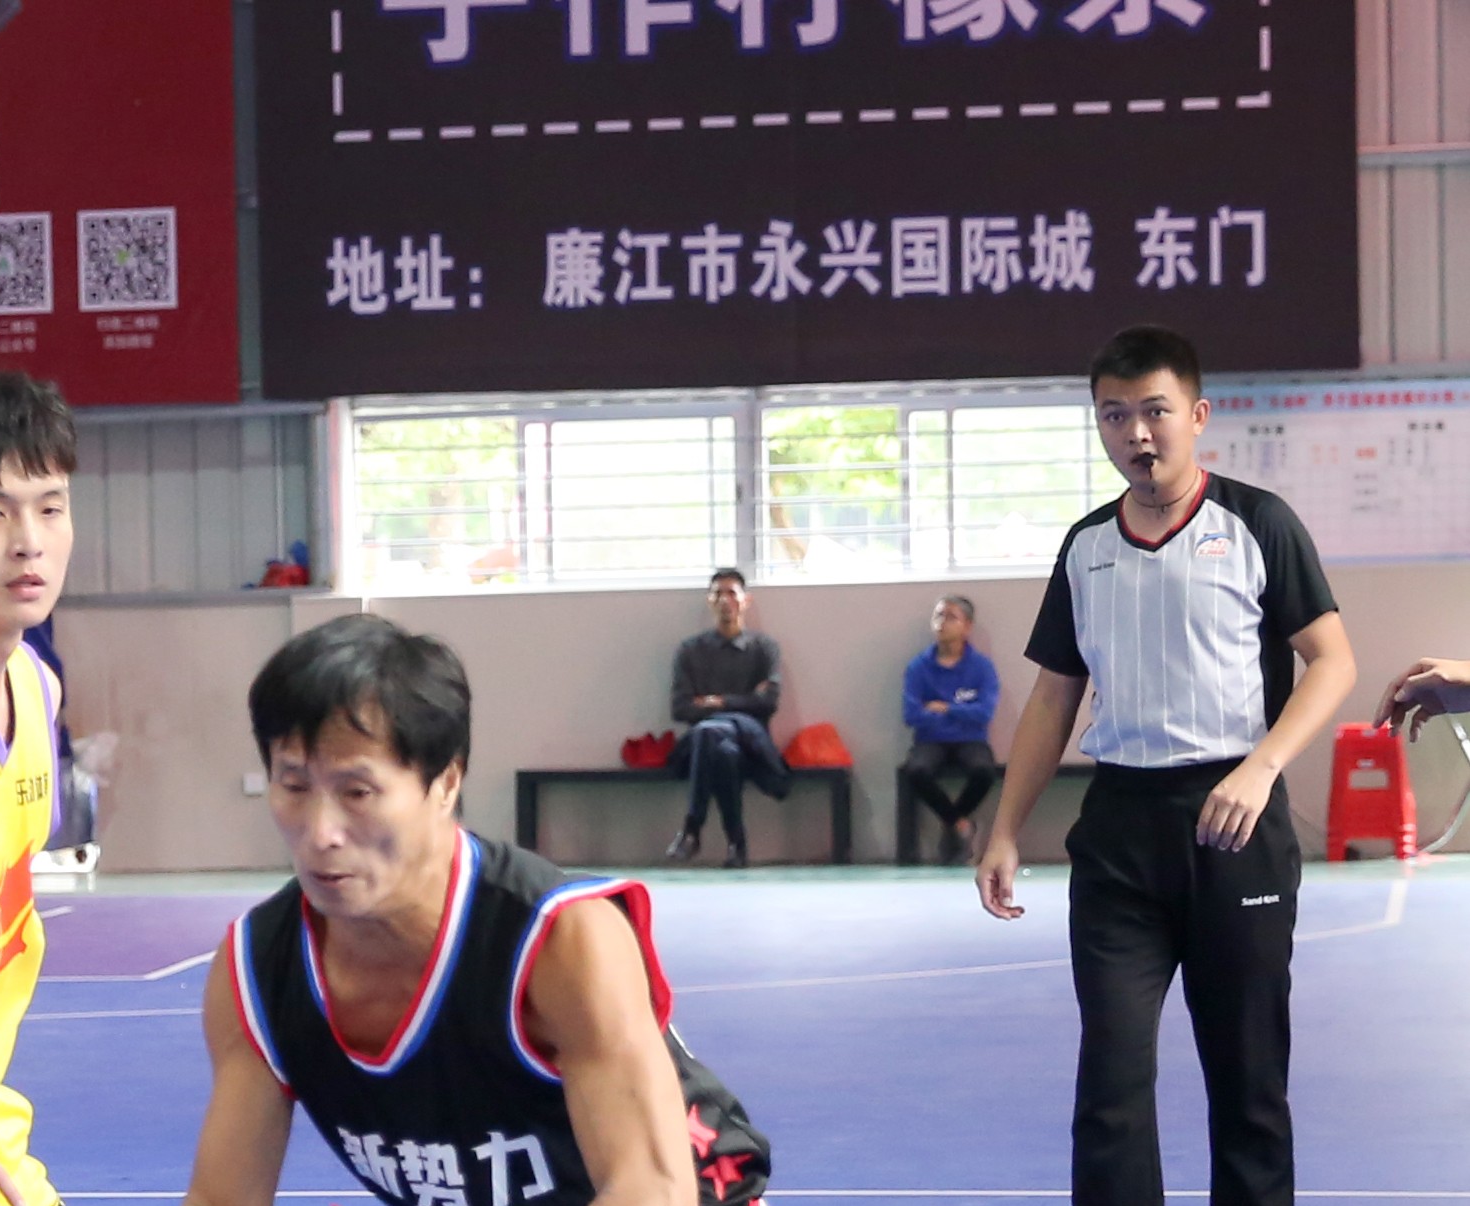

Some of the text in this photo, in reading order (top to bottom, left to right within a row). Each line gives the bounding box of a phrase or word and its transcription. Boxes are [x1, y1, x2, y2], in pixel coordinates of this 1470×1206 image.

[543, 210, 1095, 308] 廉江市永兴国际城
[1135, 207, 1268, 290] 东门
